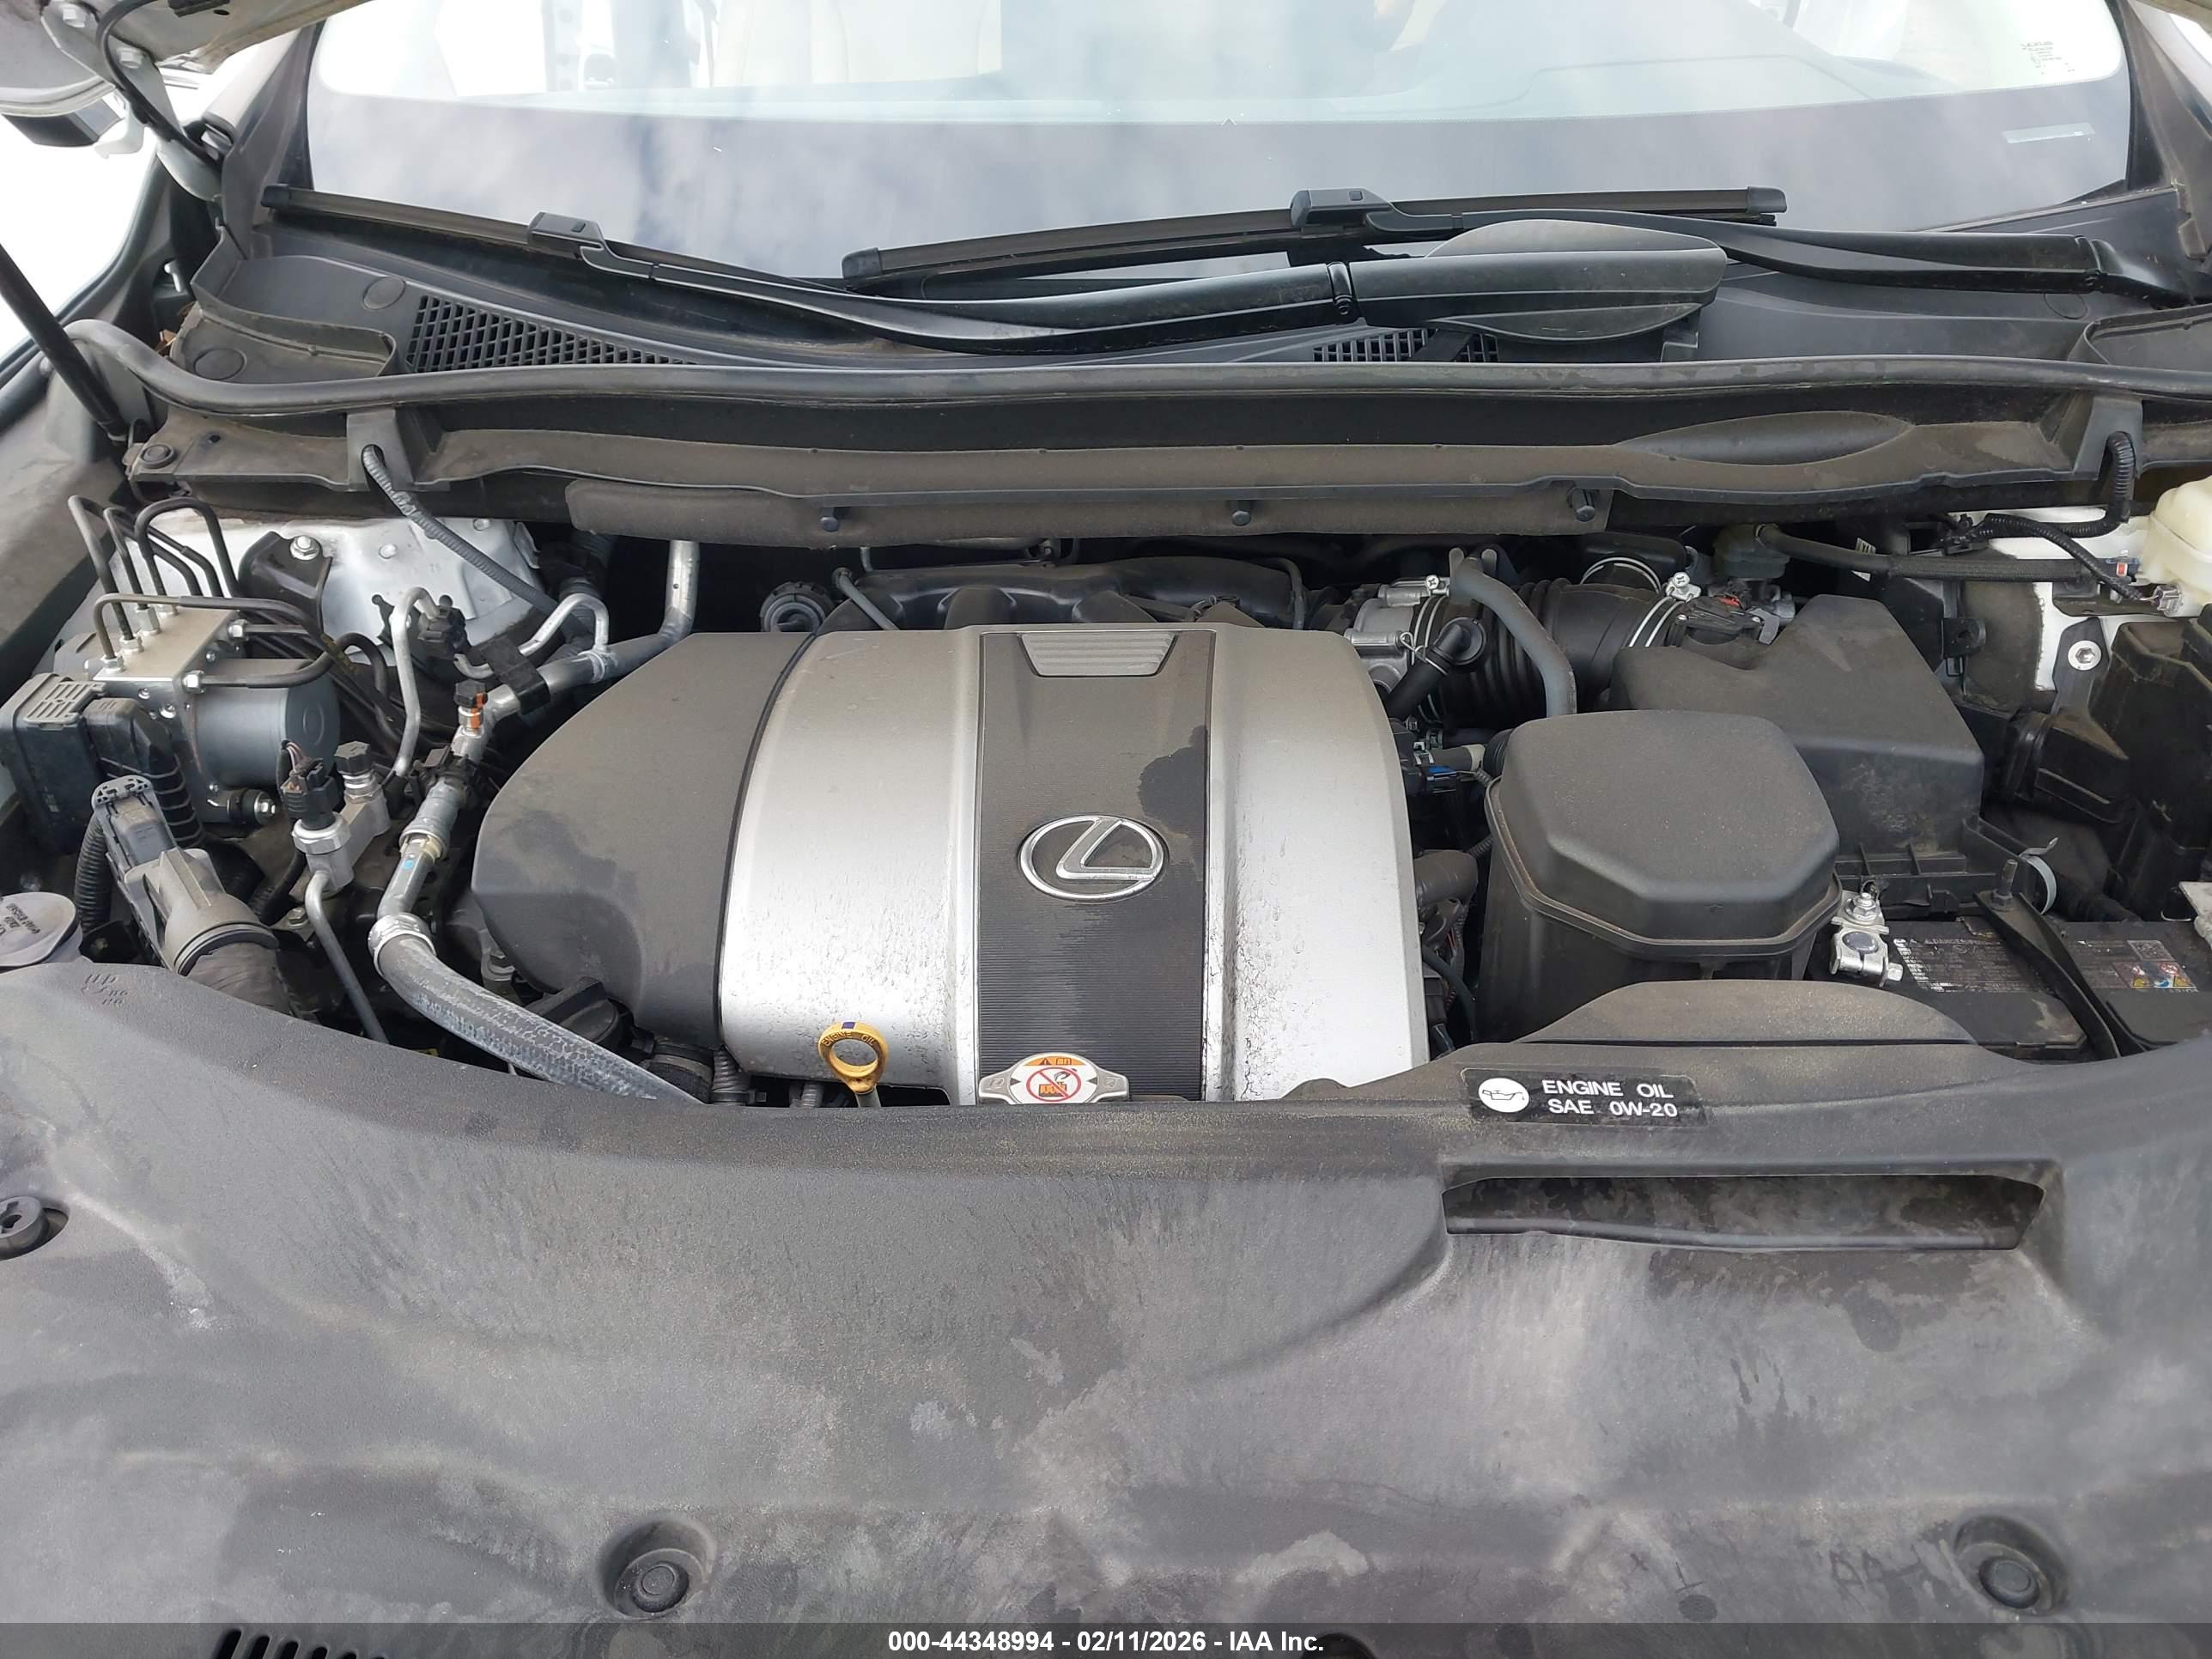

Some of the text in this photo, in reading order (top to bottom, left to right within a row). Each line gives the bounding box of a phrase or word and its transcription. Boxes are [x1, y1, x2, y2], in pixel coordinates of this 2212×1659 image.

[860, 1034, 874, 1046] OIL
[1541, 1079, 1674, 1098] ENGINE OIL
[1547, 1099, 1678, 1117] SAE 0W-20
